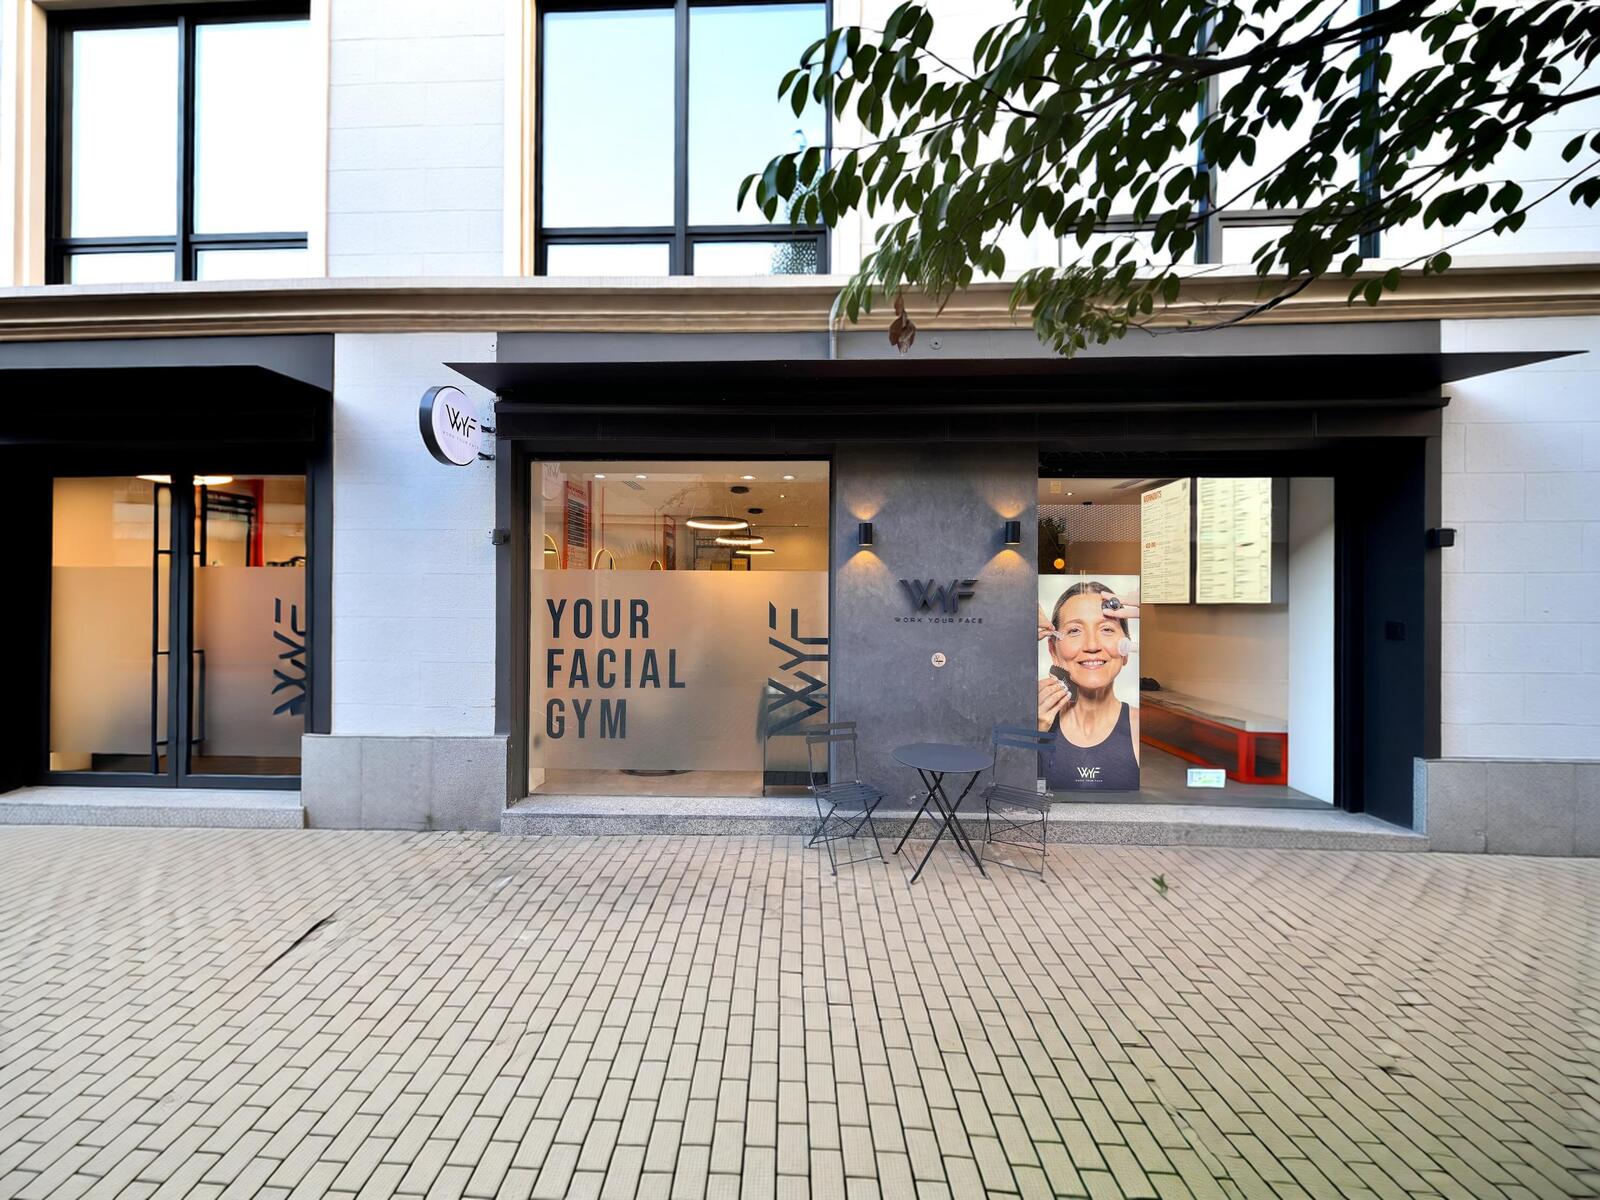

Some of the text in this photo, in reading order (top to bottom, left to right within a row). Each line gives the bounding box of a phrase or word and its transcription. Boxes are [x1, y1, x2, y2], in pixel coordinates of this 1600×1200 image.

[445, 403, 477, 438] WYF
[899, 579, 979, 614] WYF
[546, 598, 649, 639] YOUR
[546, 648, 686, 689] FACIAL
[767, 600, 828, 739] WYF
[546, 698, 627, 739] GYM
[1076, 766, 1102, 779] WYF
